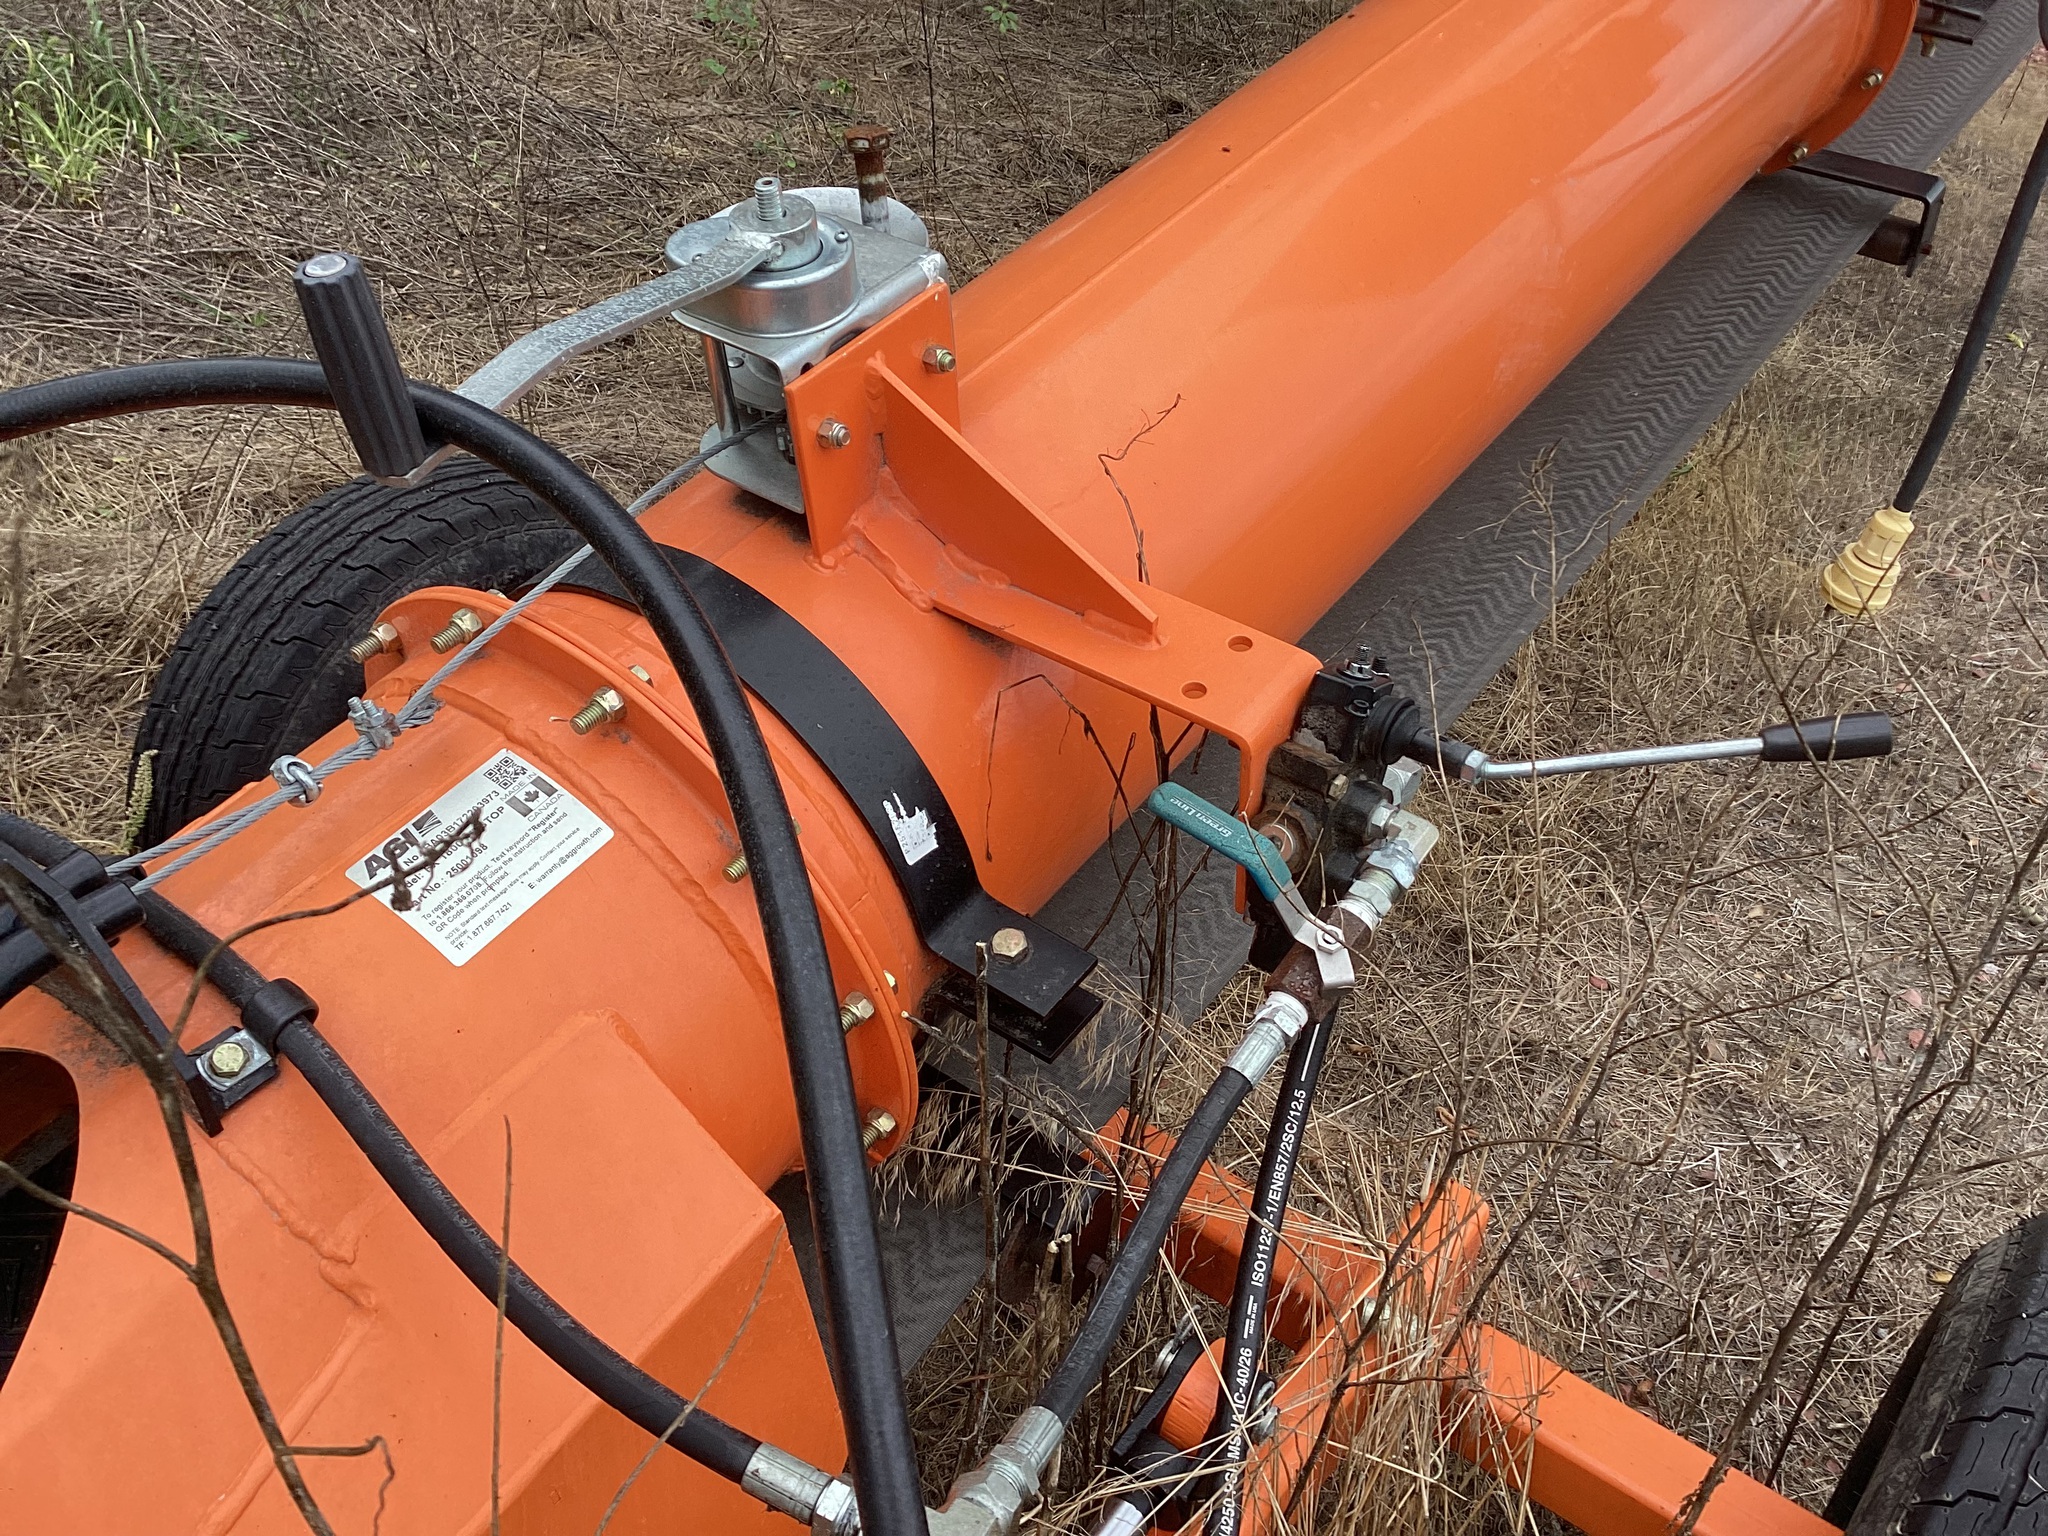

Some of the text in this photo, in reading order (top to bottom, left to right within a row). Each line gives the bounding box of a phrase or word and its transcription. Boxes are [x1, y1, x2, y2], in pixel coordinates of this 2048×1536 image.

[499, 771, 537, 801] MADE IN
[526, 791, 564, 822] CANADA
[362, 827, 421, 880] AGI
[533, 825, 604, 884] warranty@aggrowth.com
[563, 826, 580, 840] service
[421, 911, 432, 921] To
[429, 892, 456, 915] register
[453, 881, 470, 896] your
[489, 850, 507, 864] Text
[503, 830, 531, 853] keyword
[527, 805, 561, 834] "Register"
[427, 918, 438, 927] to
[481, 863, 504, 882] Follow
[500, 855, 514, 866] the
[510, 831, 542, 858] instruction
[539, 822, 554, 834] and
[551, 811, 568, 825] send
[433, 920, 448, 933] QR
[445, 906, 465, 923] Code
[462, 893, 482, 909] when
